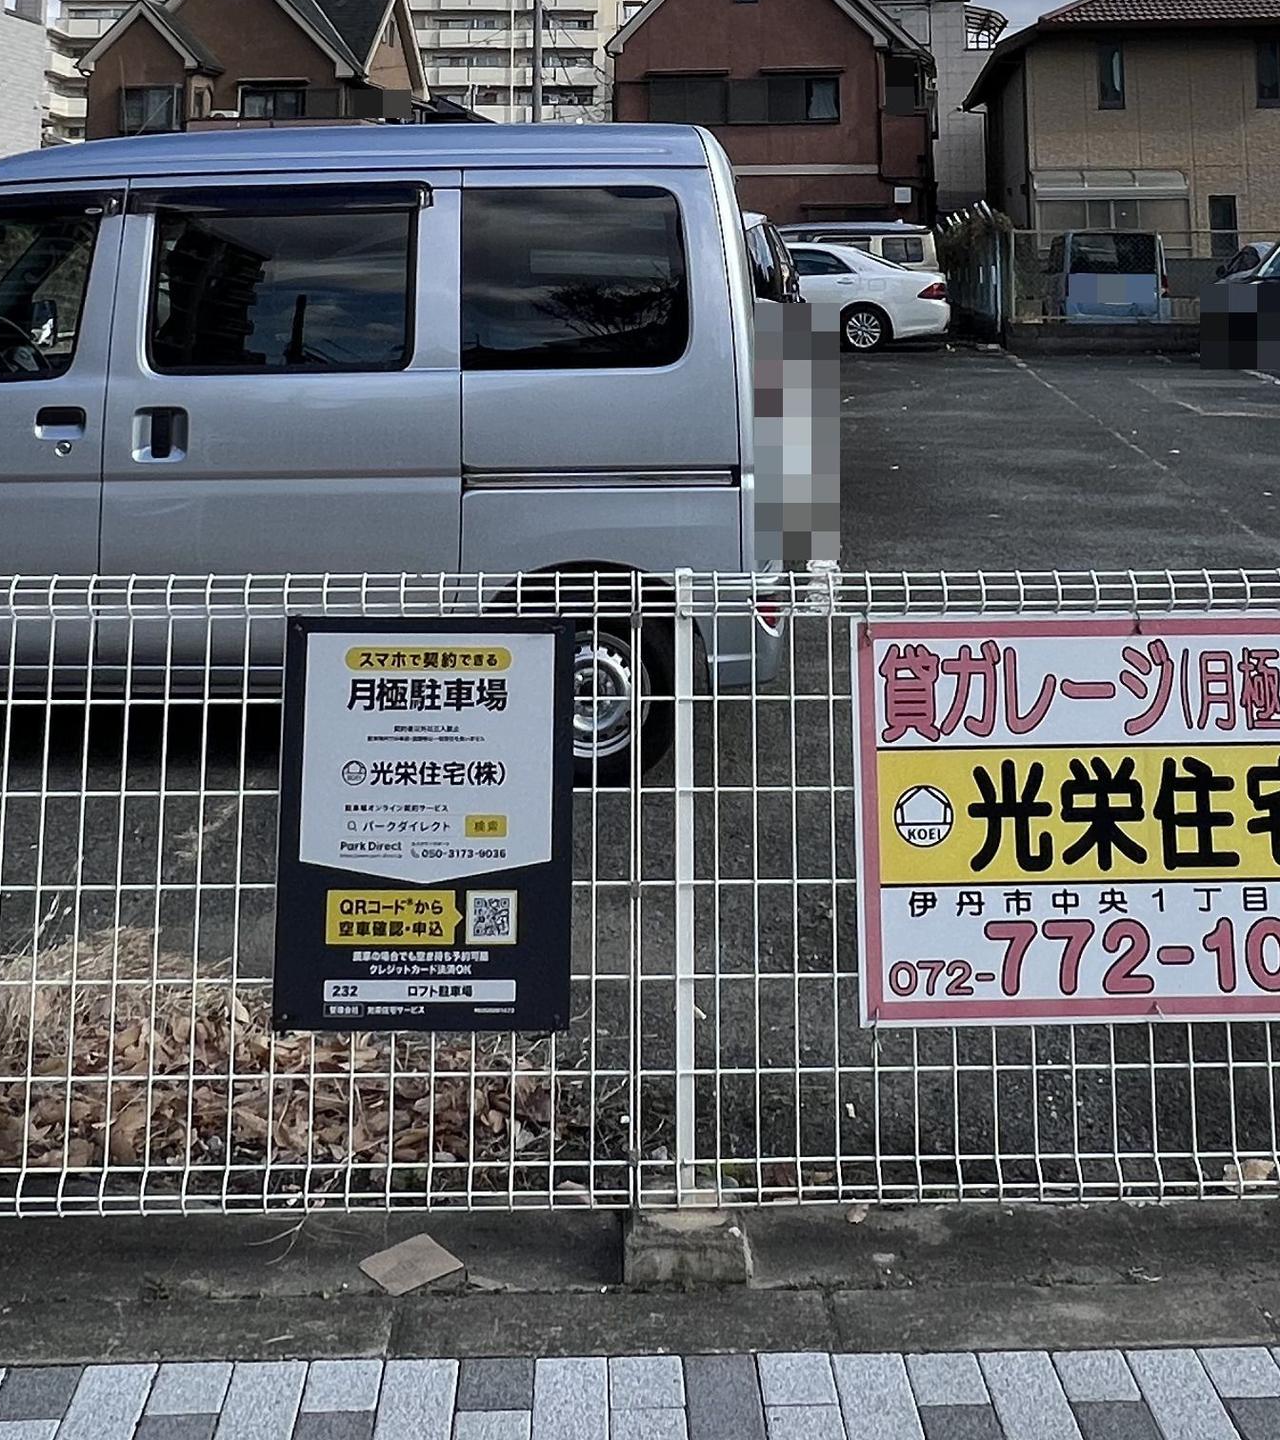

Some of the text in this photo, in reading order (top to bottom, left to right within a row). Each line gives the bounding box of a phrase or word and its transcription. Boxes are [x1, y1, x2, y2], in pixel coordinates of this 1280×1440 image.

[359, 651, 498, 669] スマホで契約できる
[346, 678, 508, 712] 月極駐車場
[370, 761, 506, 787] 光栄住宅(株)
[363, 820, 451, 833] パークダイレクト
[906, 828, 943, 841] KOEI
[340, 841, 367, 852] Park
[368, 841, 403, 852] Direct
[331, 985, 358, 997] 232
[407, 985, 473, 998] ロフト駐車場
